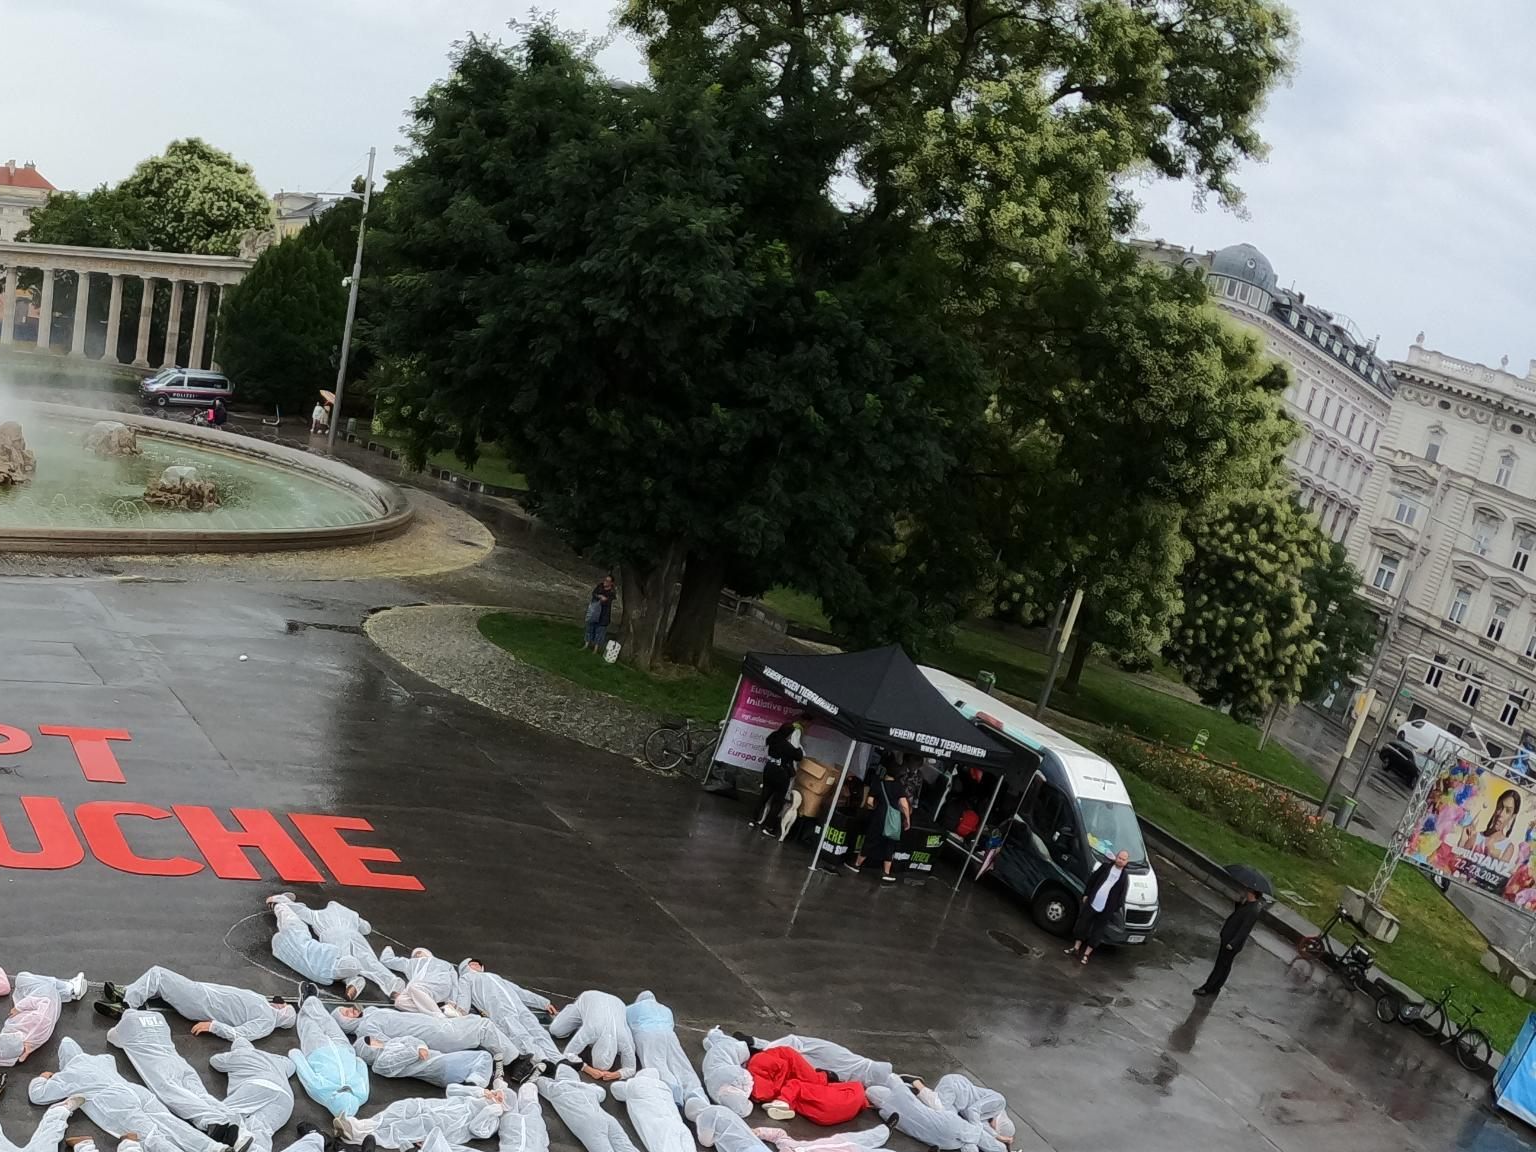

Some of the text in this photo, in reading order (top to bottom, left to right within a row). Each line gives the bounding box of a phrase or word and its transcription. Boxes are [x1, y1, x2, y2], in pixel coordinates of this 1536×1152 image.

[746, 697, 782, 712] Initiative
[889, 727, 986, 758] VEREIN GEGEN TIERFABRIKEN
[727, 747, 756, 761] Europa
